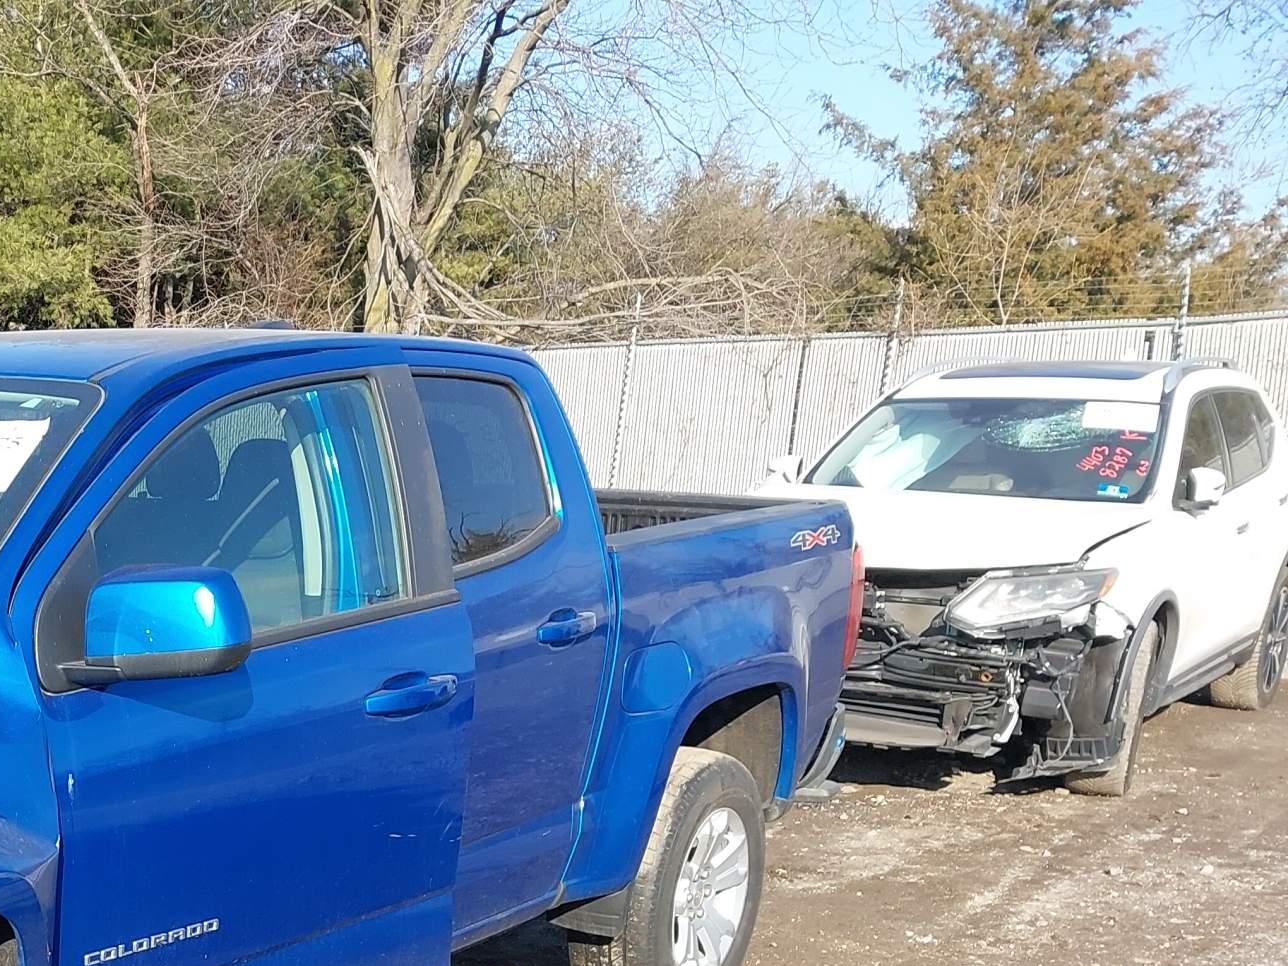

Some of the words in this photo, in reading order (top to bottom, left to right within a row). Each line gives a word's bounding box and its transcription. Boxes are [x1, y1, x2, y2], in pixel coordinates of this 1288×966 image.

[1075, 445, 1109, 471] 4403
[1098, 446, 1133, 478] 8287
[83, 918, 220, 966] COLORADO
